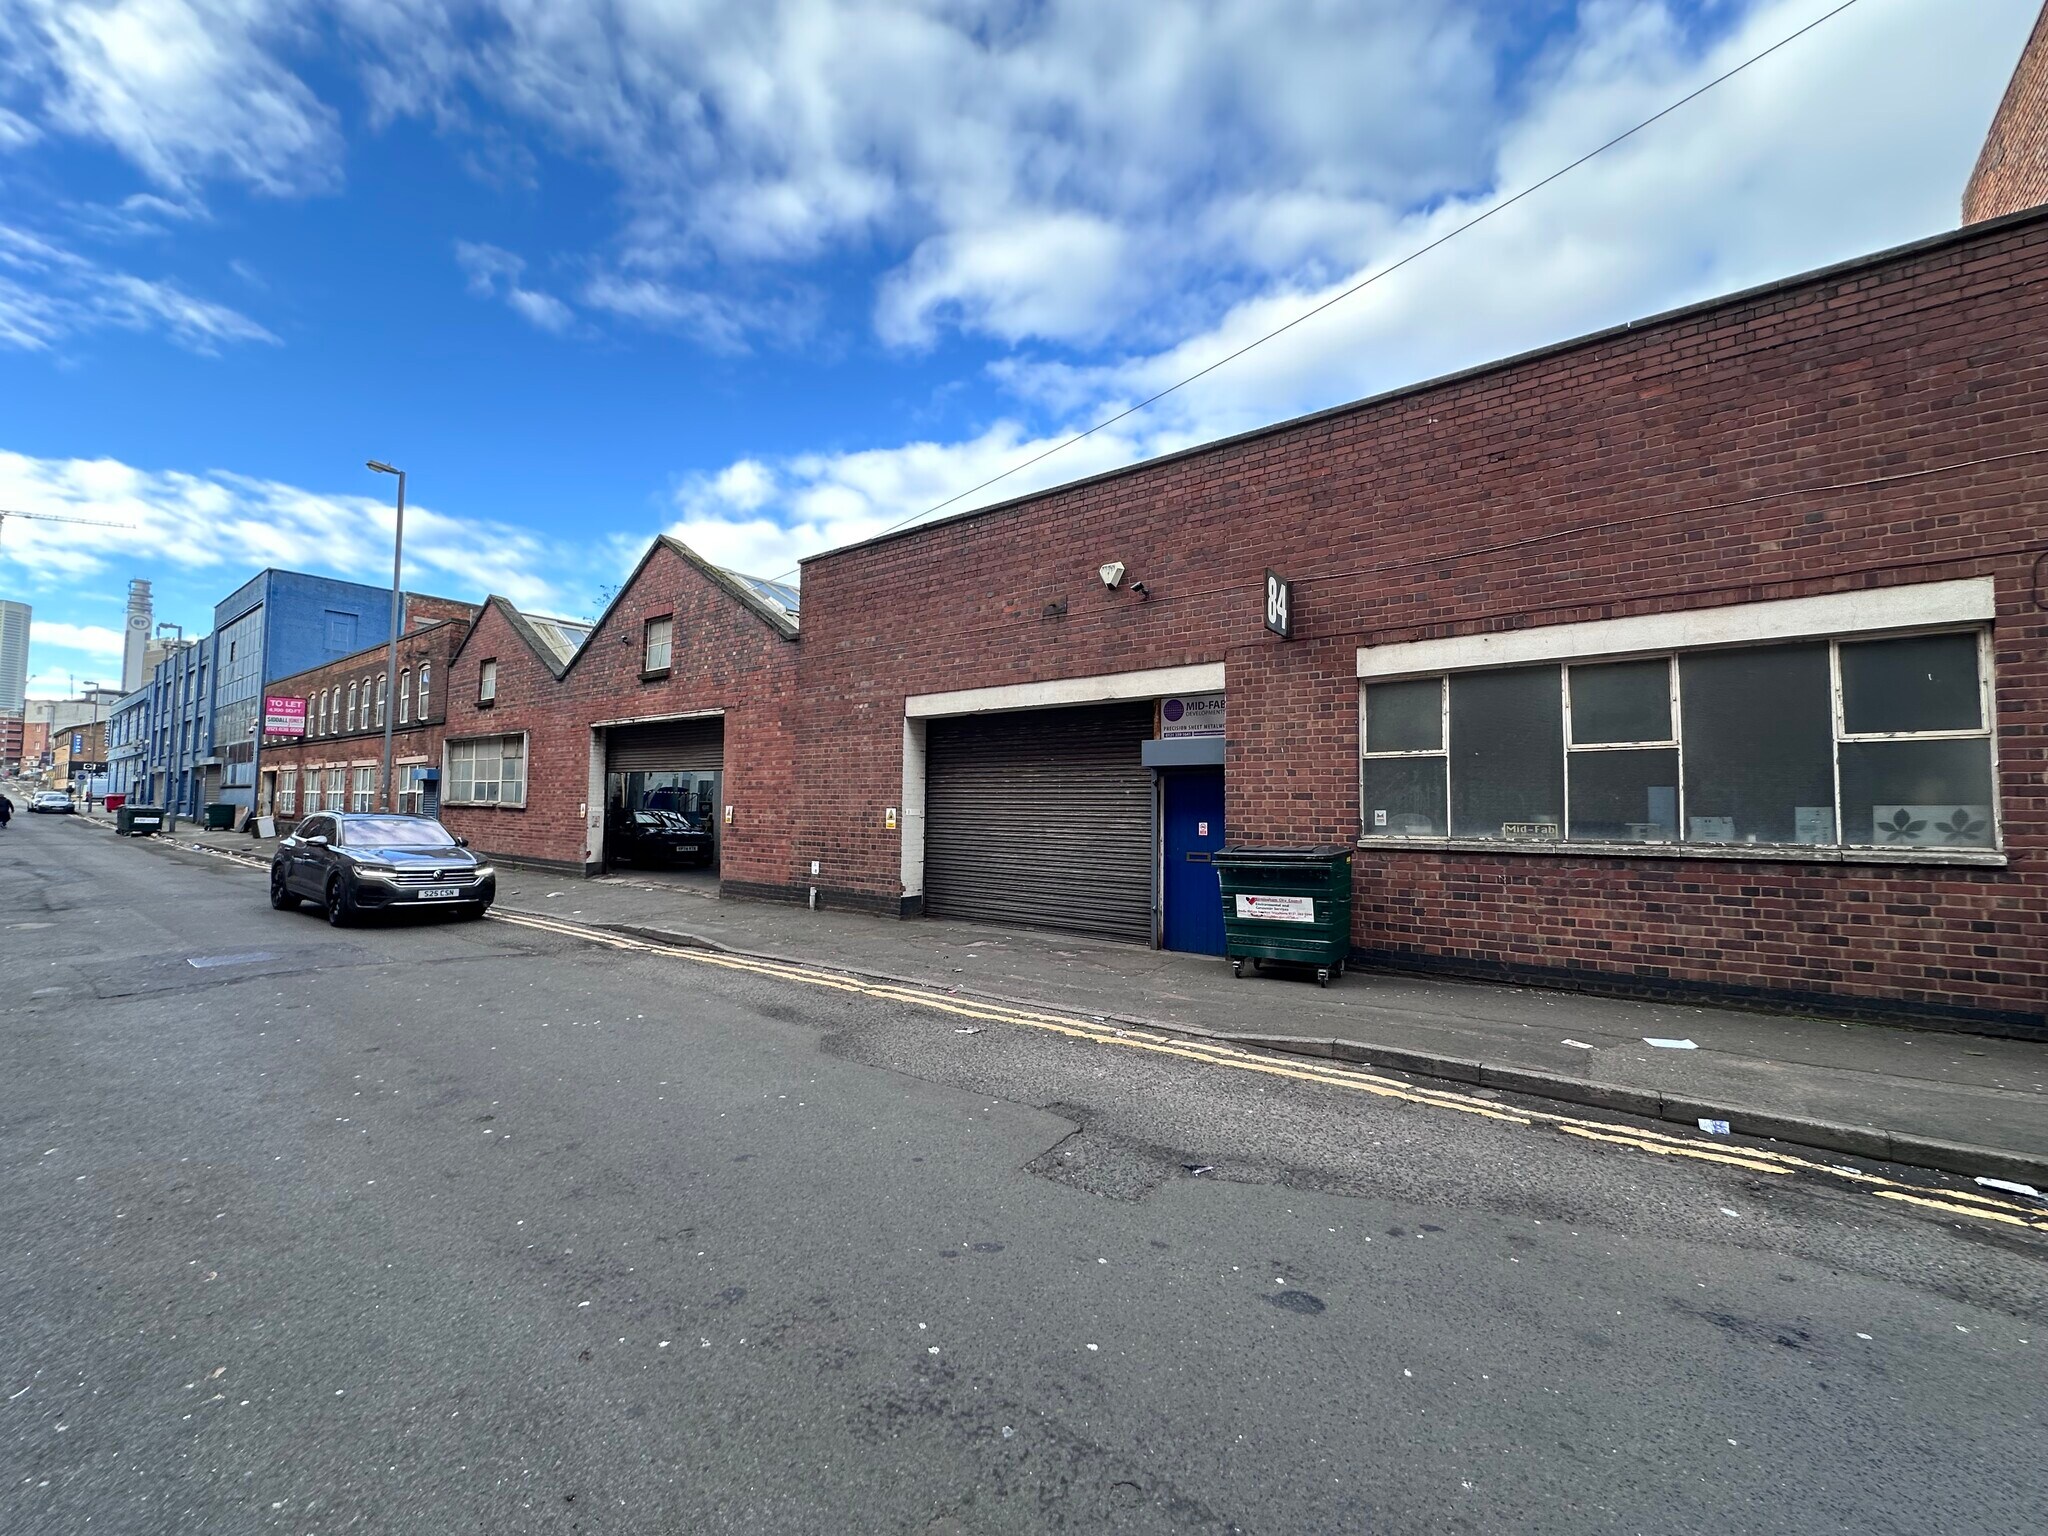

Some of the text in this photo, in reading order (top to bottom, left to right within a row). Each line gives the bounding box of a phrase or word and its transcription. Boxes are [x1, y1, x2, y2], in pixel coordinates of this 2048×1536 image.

[1268, 576, 1286, 629] 84
[270, 699, 303, 708] TO LET
[1186, 700, 1226, 711] MID-FAB
[1506, 825, 1555, 834] Mid-Fab
